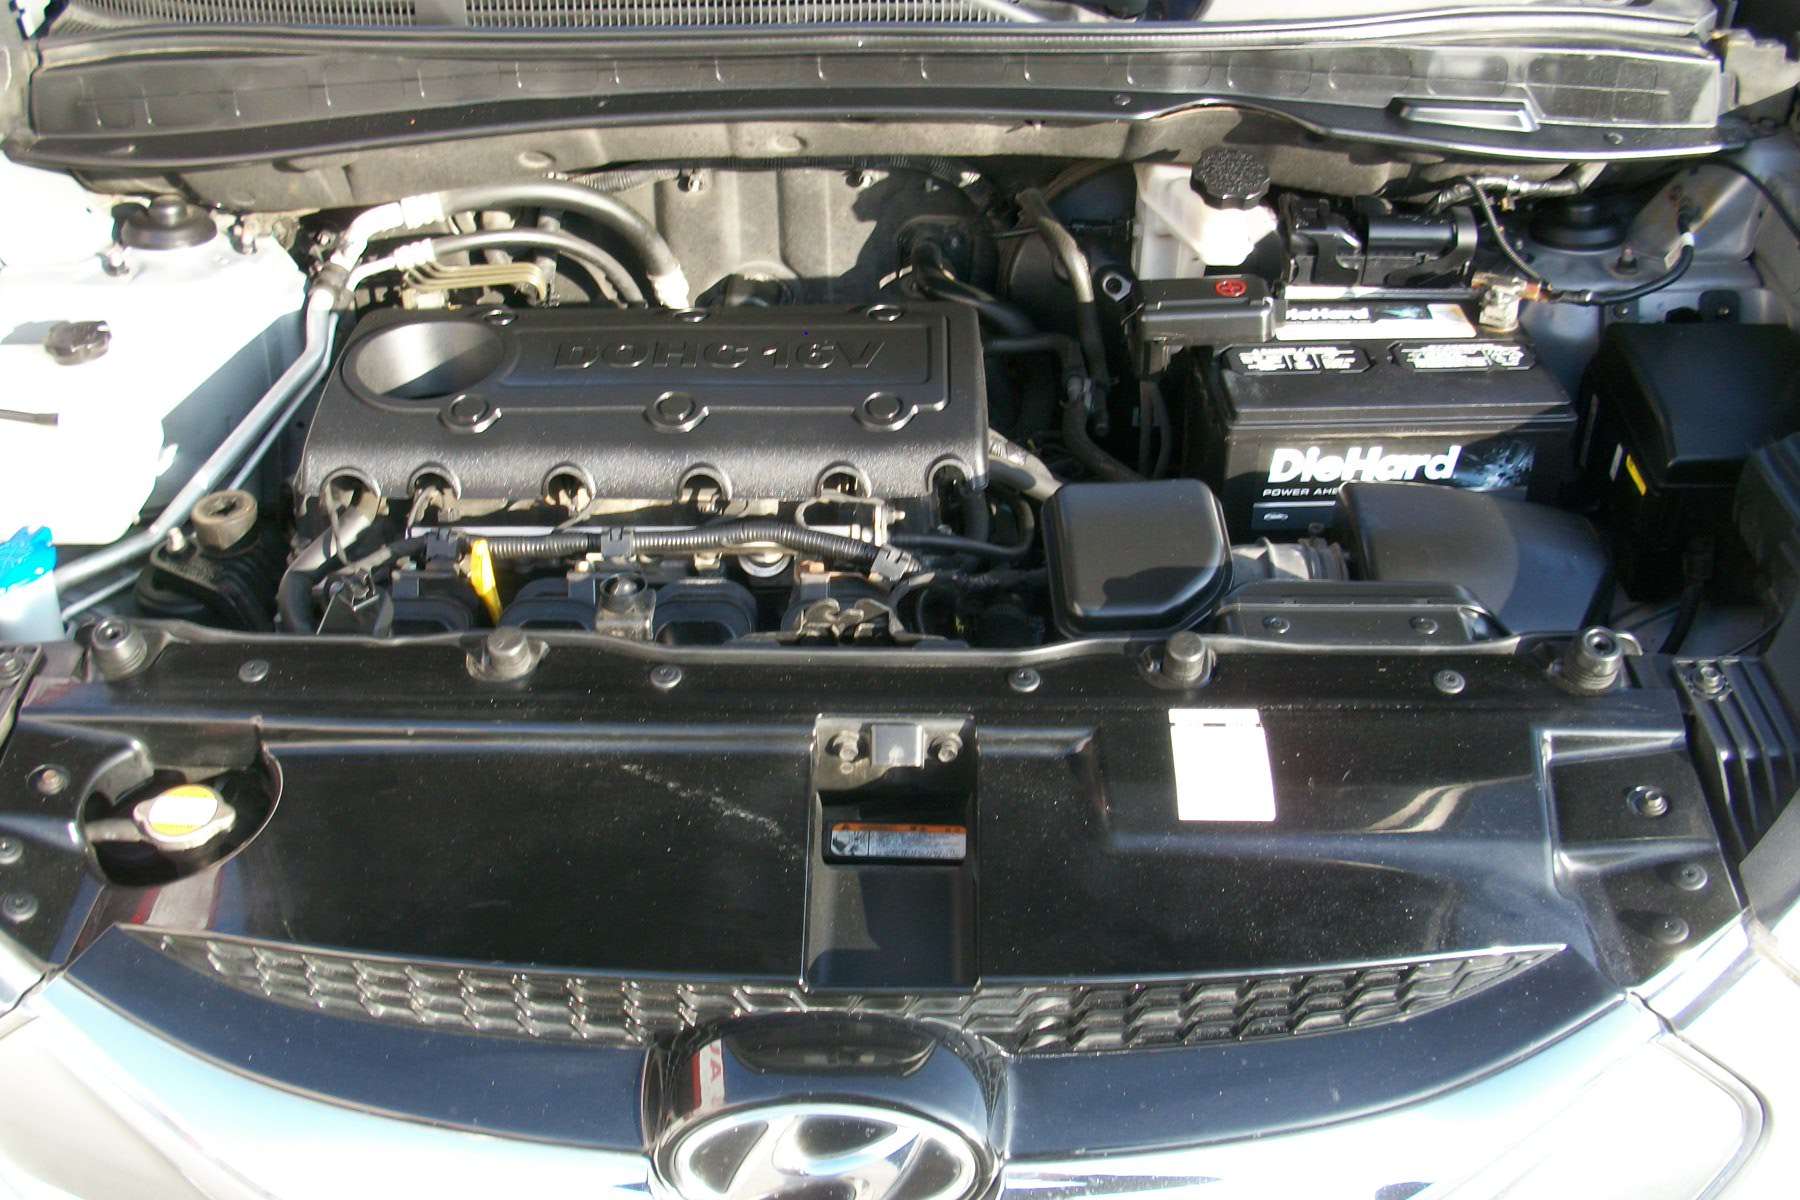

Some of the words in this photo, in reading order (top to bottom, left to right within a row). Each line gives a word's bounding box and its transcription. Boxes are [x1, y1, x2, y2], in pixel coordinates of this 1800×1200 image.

[555, 340, 749, 370] DOHC
[762, 339, 885, 369] 16V
[1267, 445, 1463, 483] DieHard
[1262, 487, 1311, 497] POWER
